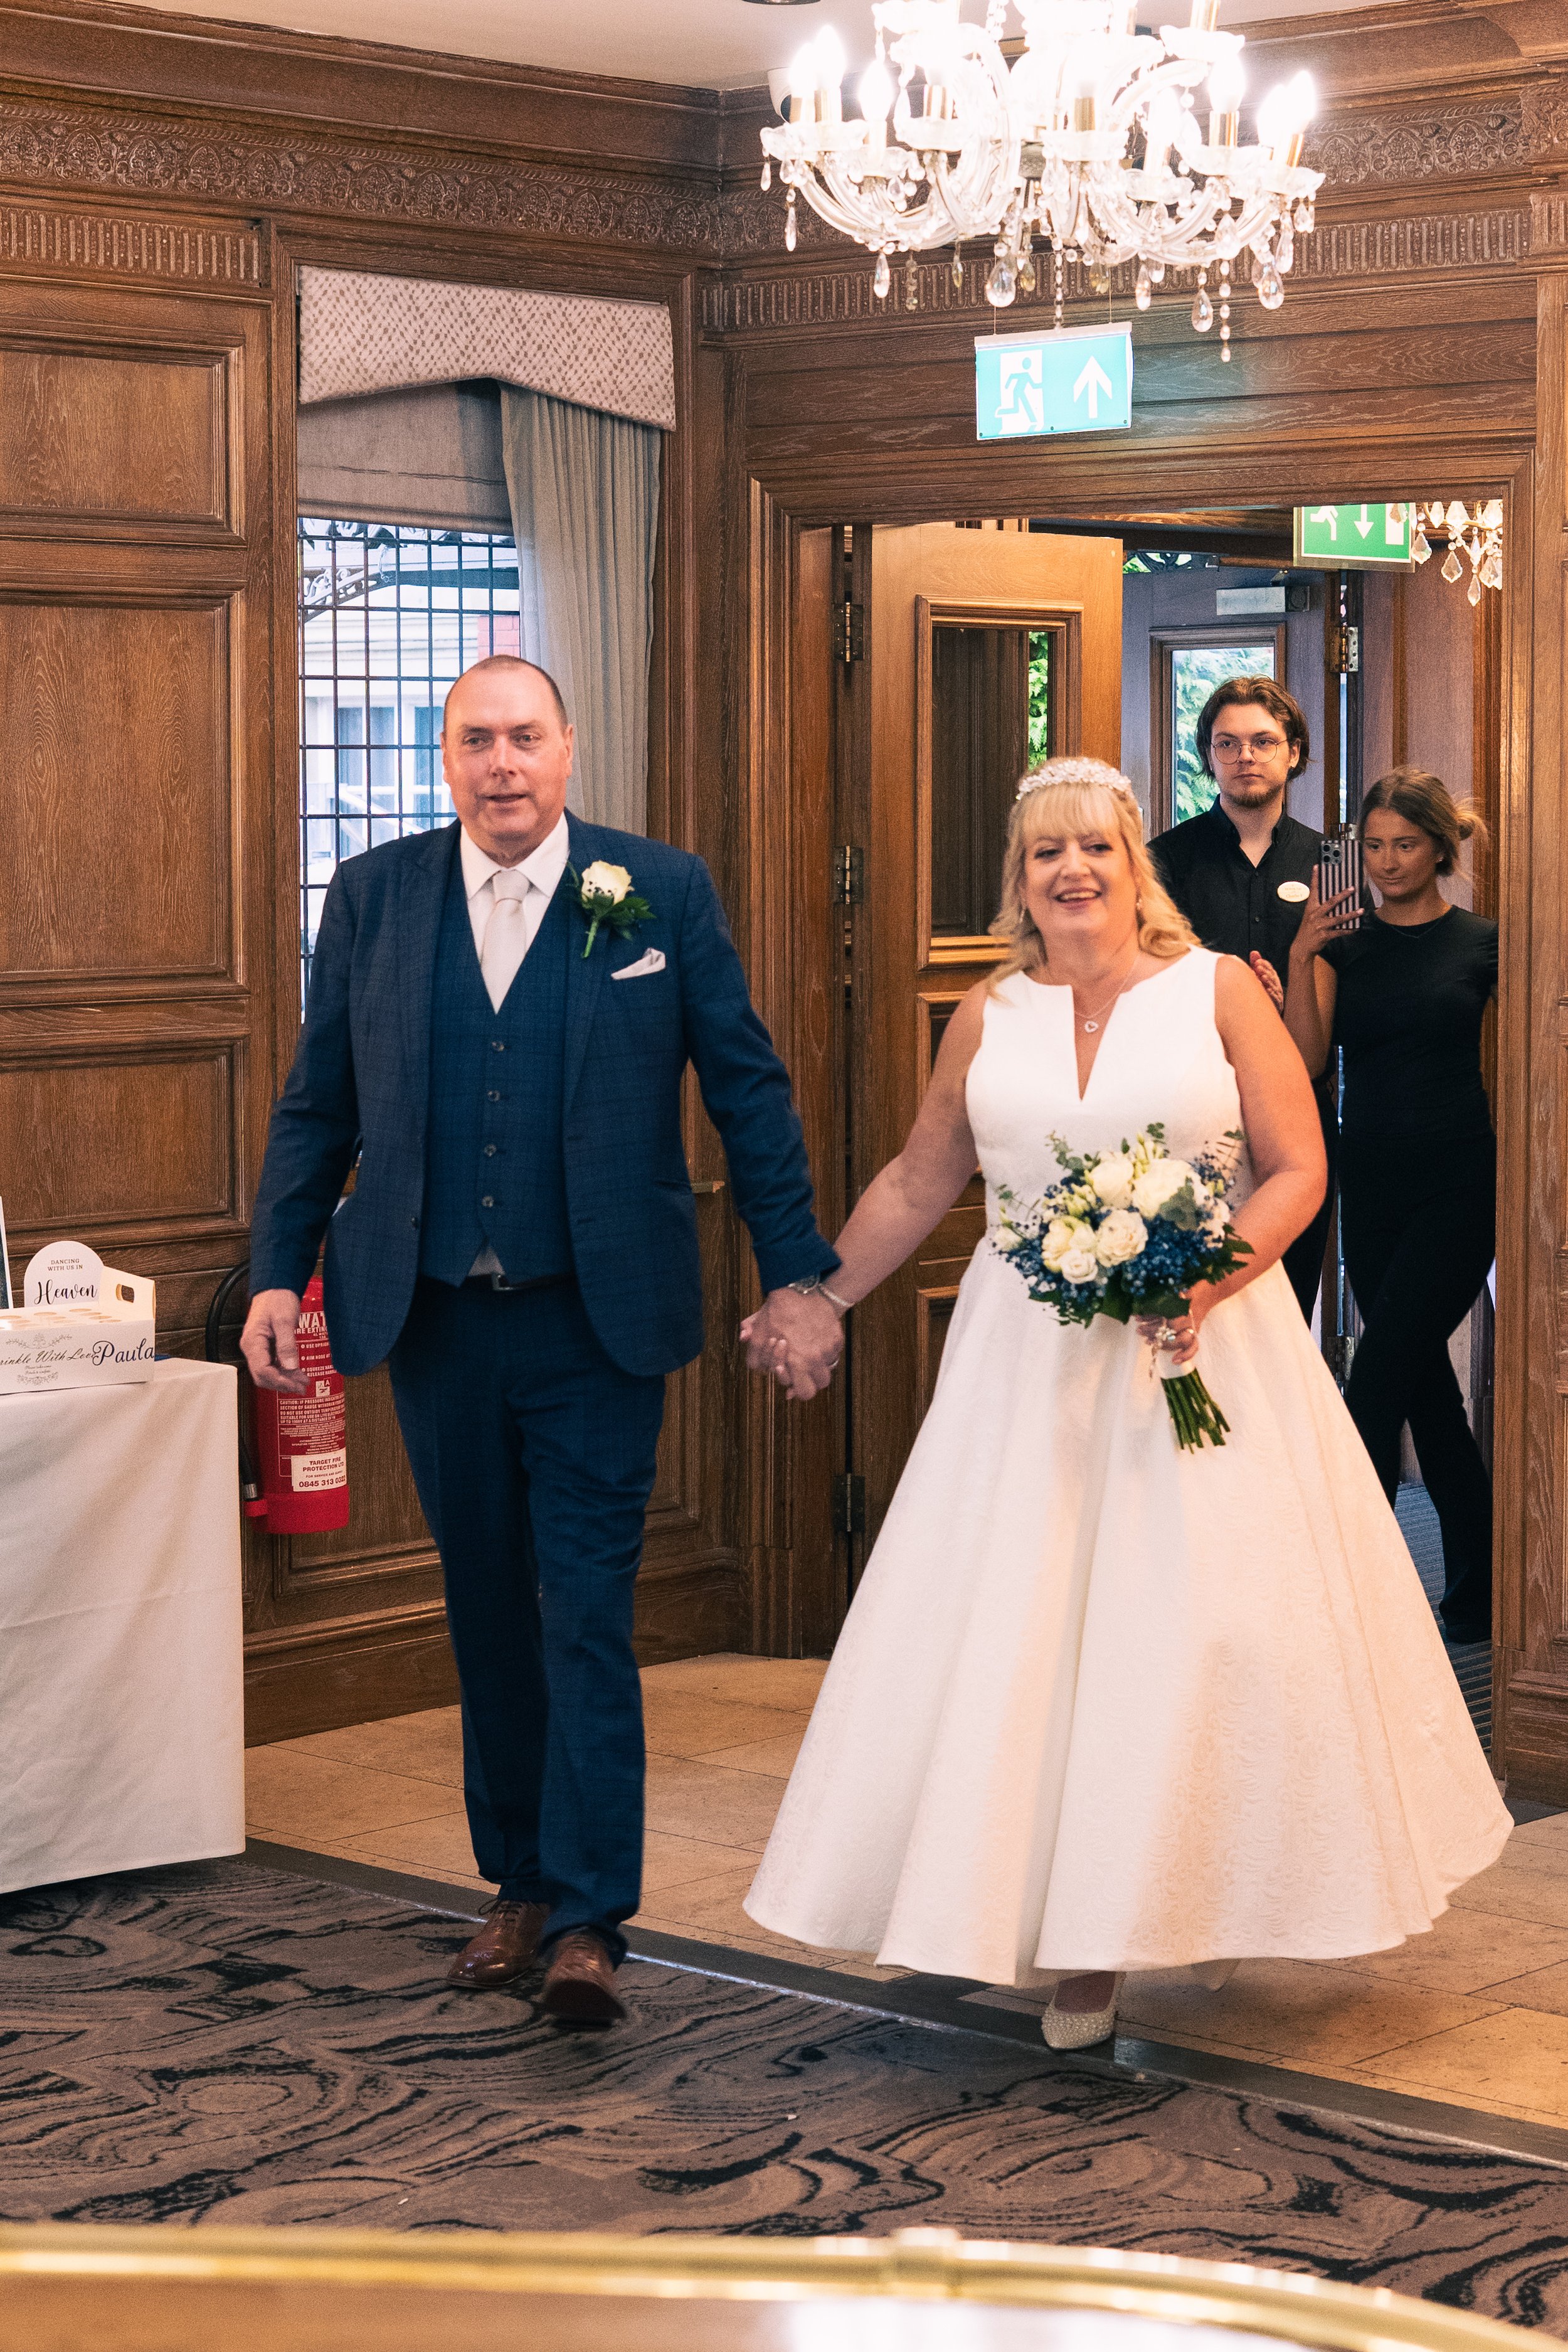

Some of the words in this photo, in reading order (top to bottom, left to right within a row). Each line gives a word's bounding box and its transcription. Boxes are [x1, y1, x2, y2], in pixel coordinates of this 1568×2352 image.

[34, 1279, 98, 1305] Heaven
[35, 1349, 67, 1363] With
[92, 1338, 154, 1366] Paula
[302, 1463, 337, 1472] PROTECTION
[321, 1478, 334, 1486] 313
